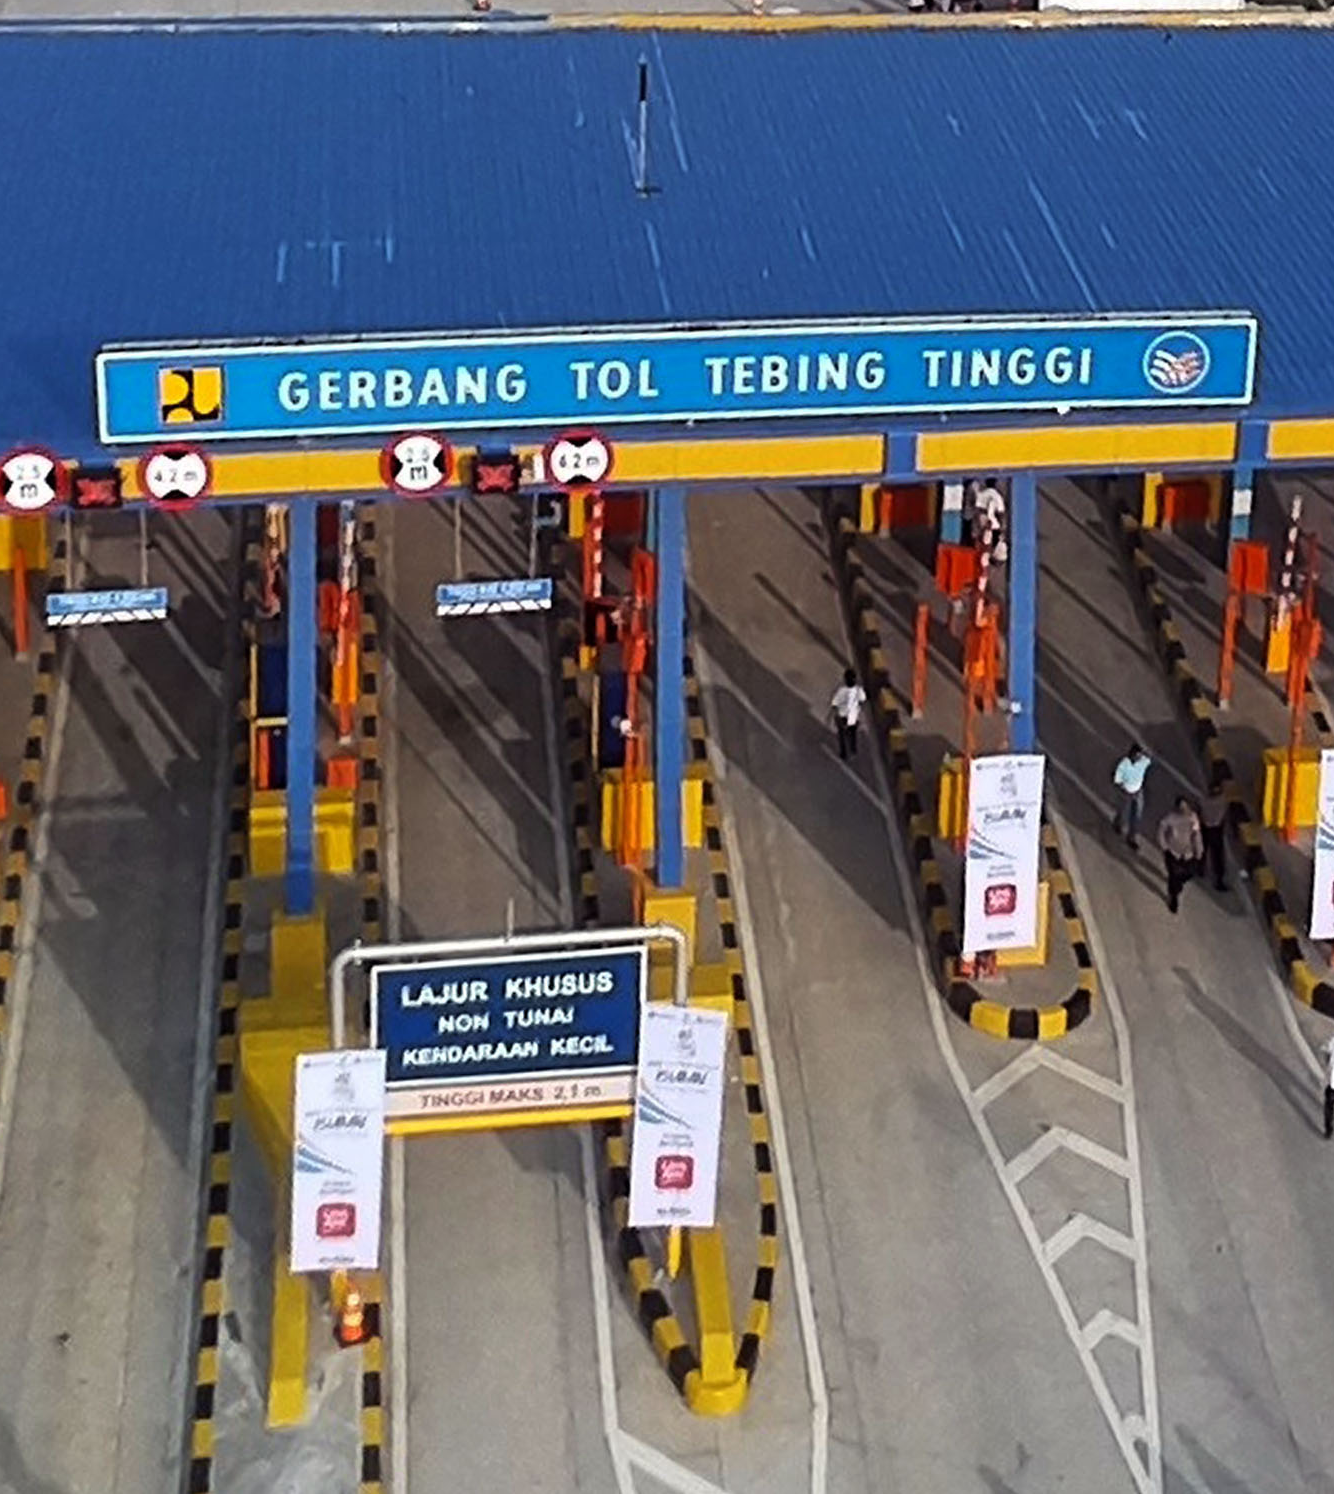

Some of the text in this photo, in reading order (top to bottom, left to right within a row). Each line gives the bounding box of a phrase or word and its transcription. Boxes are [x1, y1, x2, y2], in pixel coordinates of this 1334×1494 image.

[278, 347, 1093, 412] GERBANG TOL TEBING TINGGI
[400, 971, 614, 1007] LAJUR KHUSUS
[438, 1006, 575, 1034] NON TUNAI
[402, 1034, 615, 1067] KENDARAAN KECIL
[419, 1091, 485, 1109] TINGGI
[489, 1086, 545, 1104] MAKS
